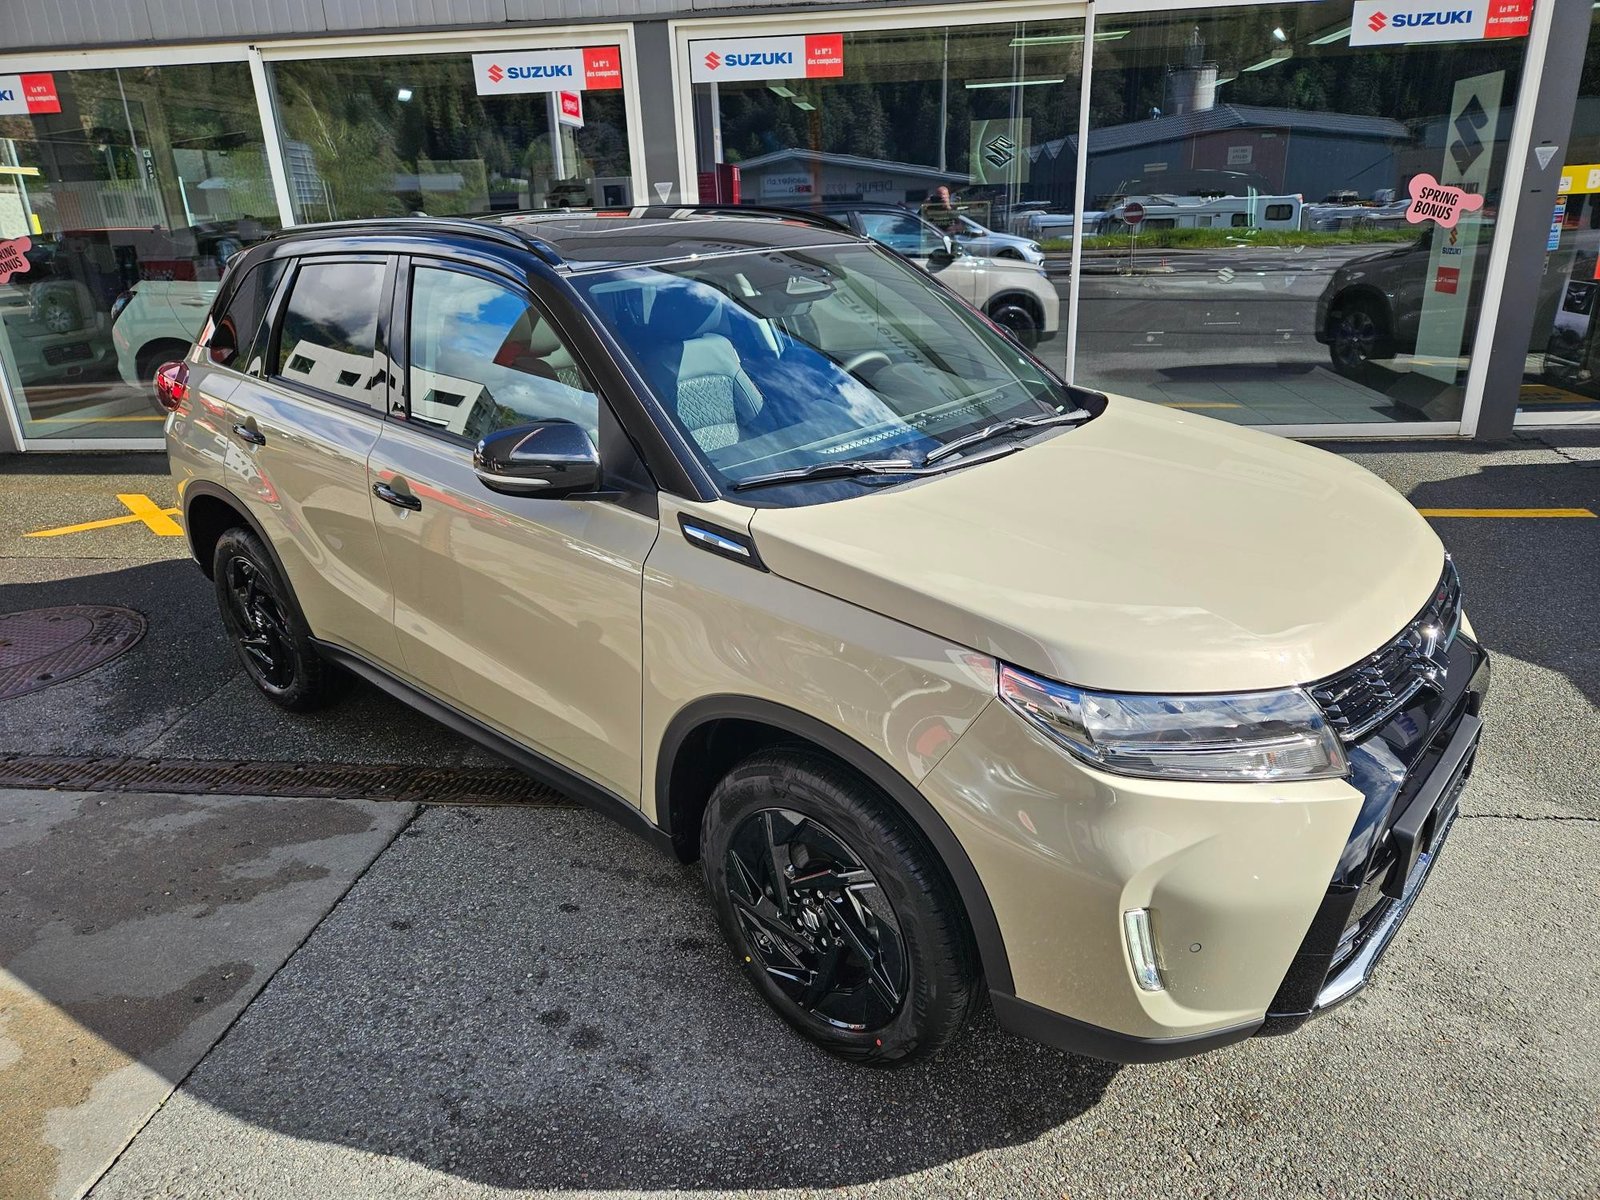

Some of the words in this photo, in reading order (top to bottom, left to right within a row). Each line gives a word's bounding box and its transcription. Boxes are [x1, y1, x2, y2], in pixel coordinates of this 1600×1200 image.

[1499, 5, 1507, 13] Le
[1391, 10, 1473, 28] SUZUKI
[1488, 16, 1499, 24] des
[1499, 15, 1529, 24] compactes
[724, 52, 793, 67] SUZUKI
[817, 57, 841, 66] compactes
[506, 64, 573, 79] SUZUKI
[1419, 187, 1460, 206] SPRING
[1413, 200, 1454, 220] BONUS
[0, 256, 23, 276] ONUS
